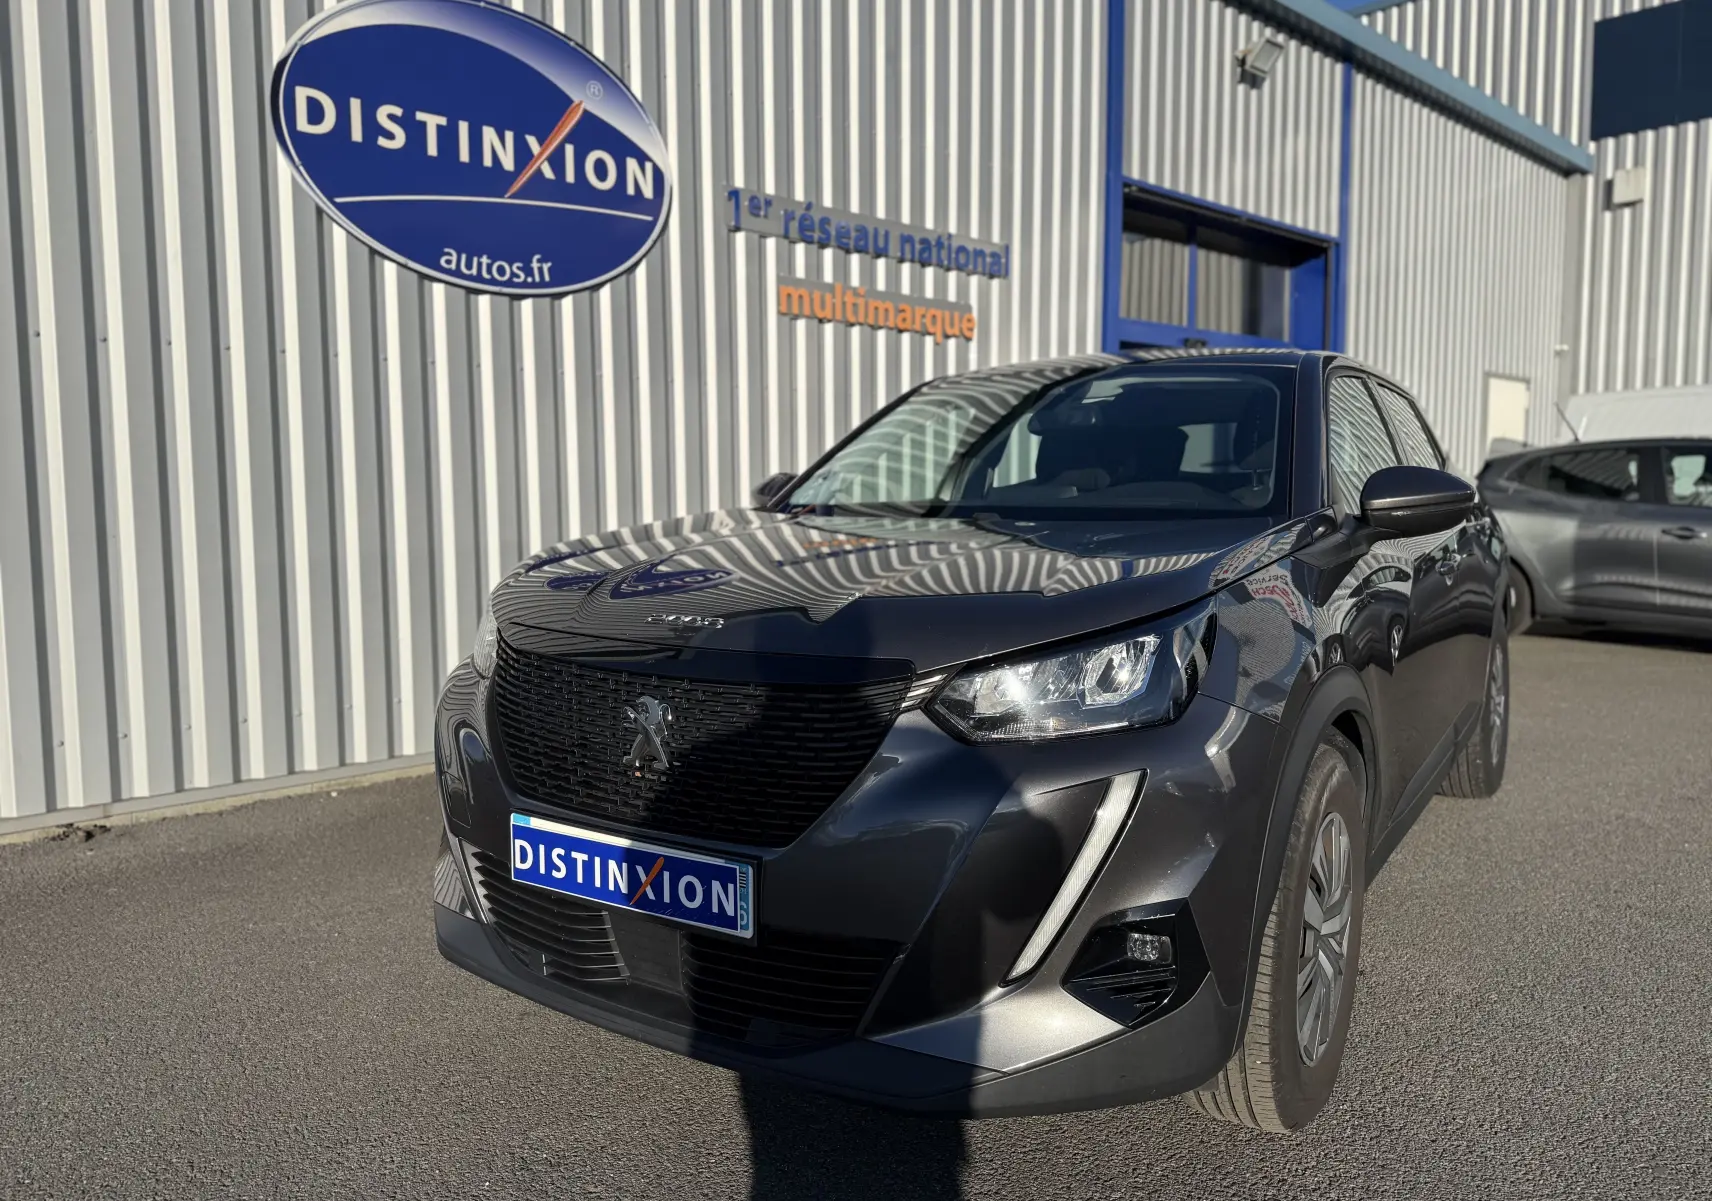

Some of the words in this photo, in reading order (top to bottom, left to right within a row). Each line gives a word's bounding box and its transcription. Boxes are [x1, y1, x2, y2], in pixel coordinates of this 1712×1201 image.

[294, 85, 654, 200] DISTINXION
[439, 247, 553, 284] autos.fr
[727, 188, 772, 229] 1er
[782, 201, 890, 255] réseau
[899, 232, 1010, 278] national
[778, 282, 977, 345] multimarque
[514, 838, 735, 917] DISTINXION
